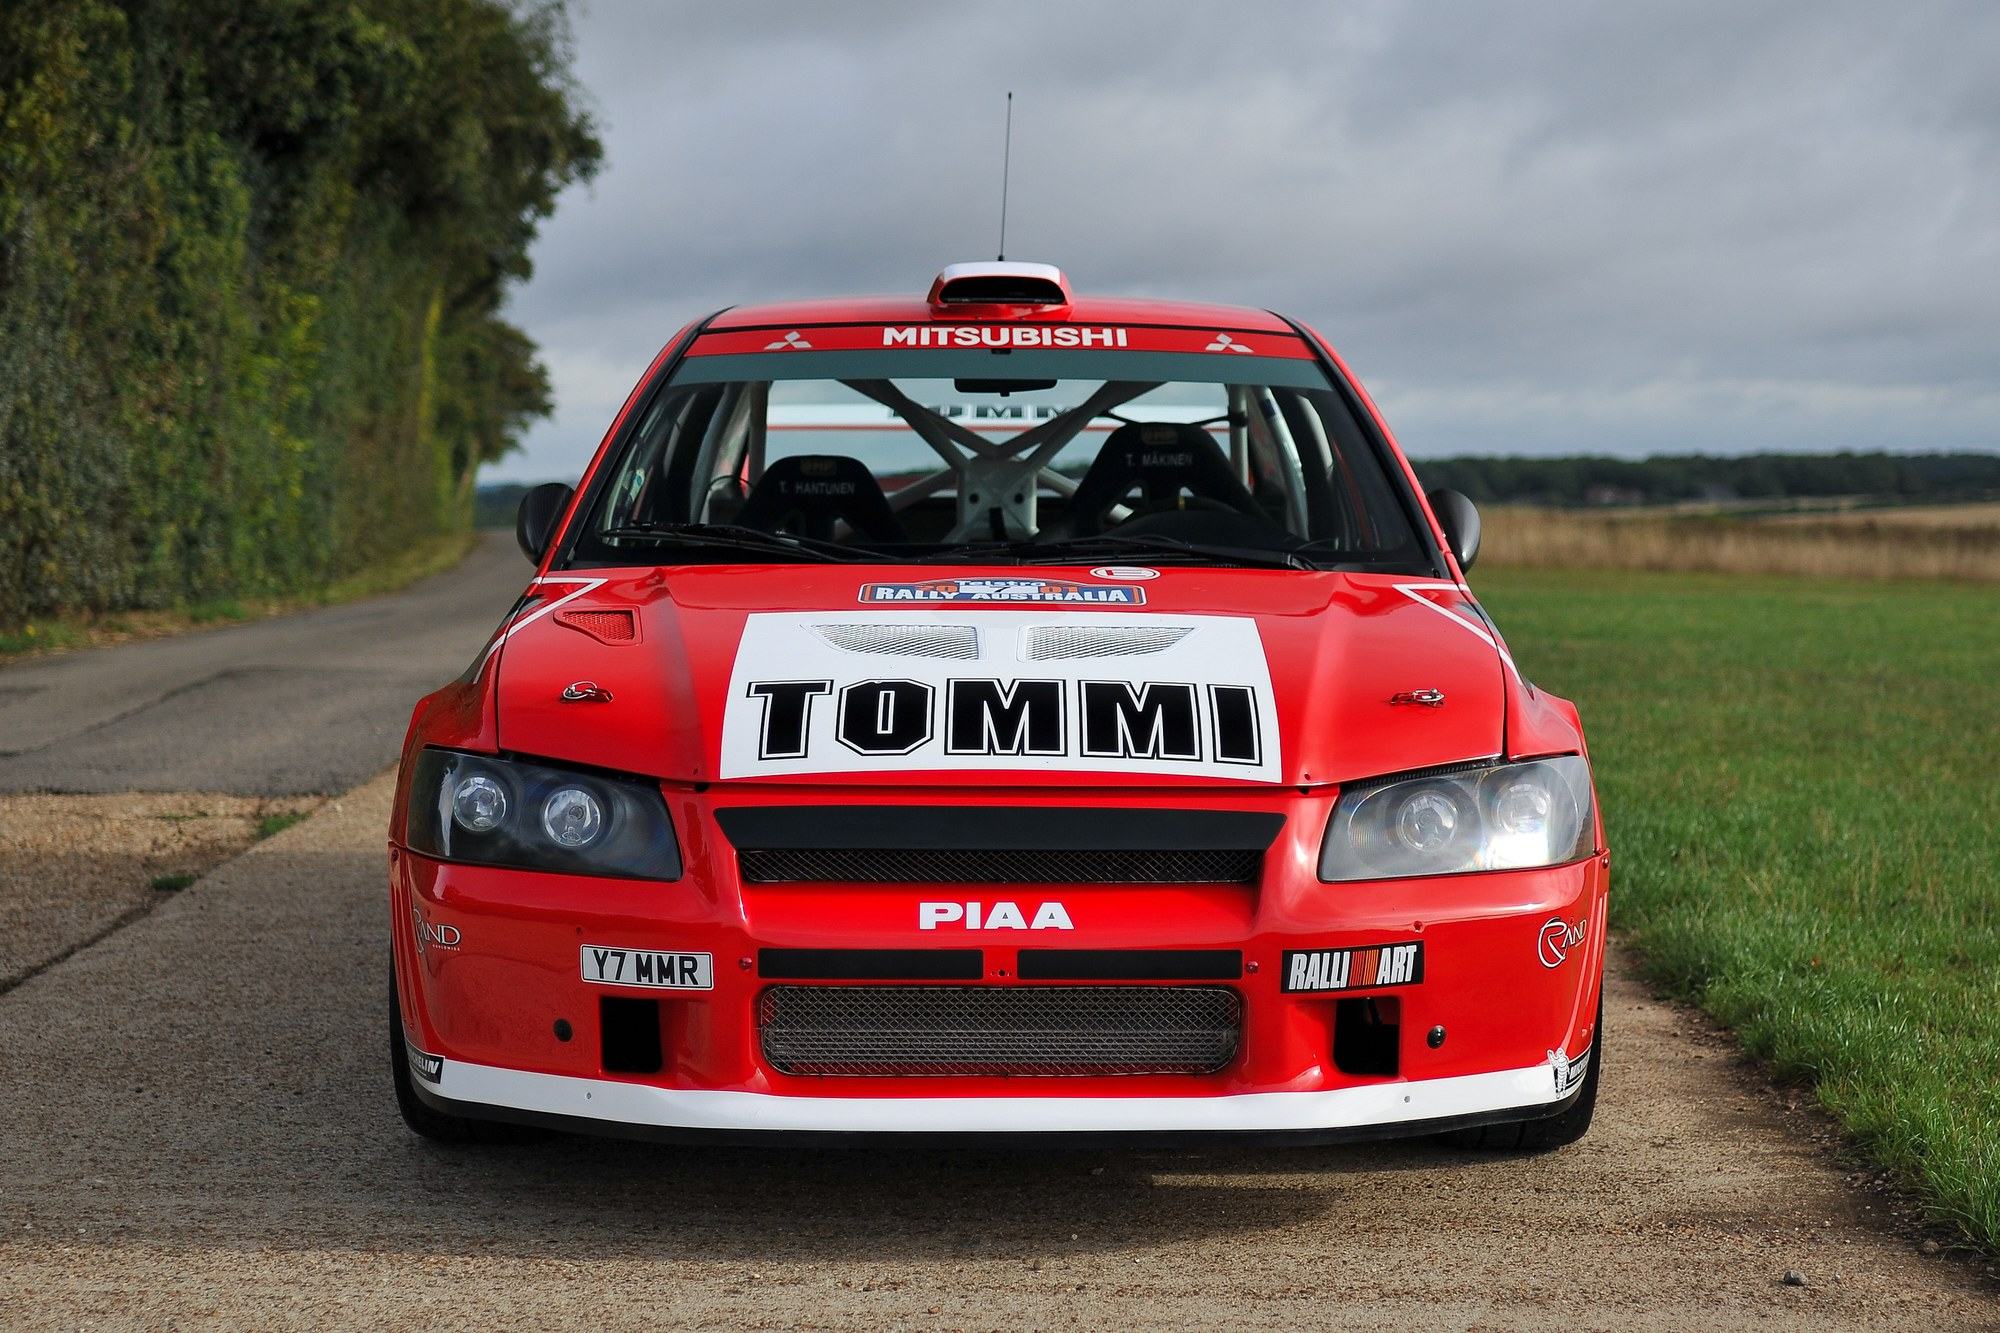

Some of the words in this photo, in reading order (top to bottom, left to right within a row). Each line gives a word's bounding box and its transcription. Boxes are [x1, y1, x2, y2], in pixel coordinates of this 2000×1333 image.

[883, 327, 1129, 347] MITSUBISHI
[795, 482, 855, 495] HANTUNEN
[875, 586, 962, 600] RALLY
[969, 587, 1129, 602] AUSTRALIA
[746, 677, 1263, 767] TOMMI
[919, 901, 1075, 930] PIAA
[593, 949, 627, 980] Y7
[635, 953, 699, 985] MMR
